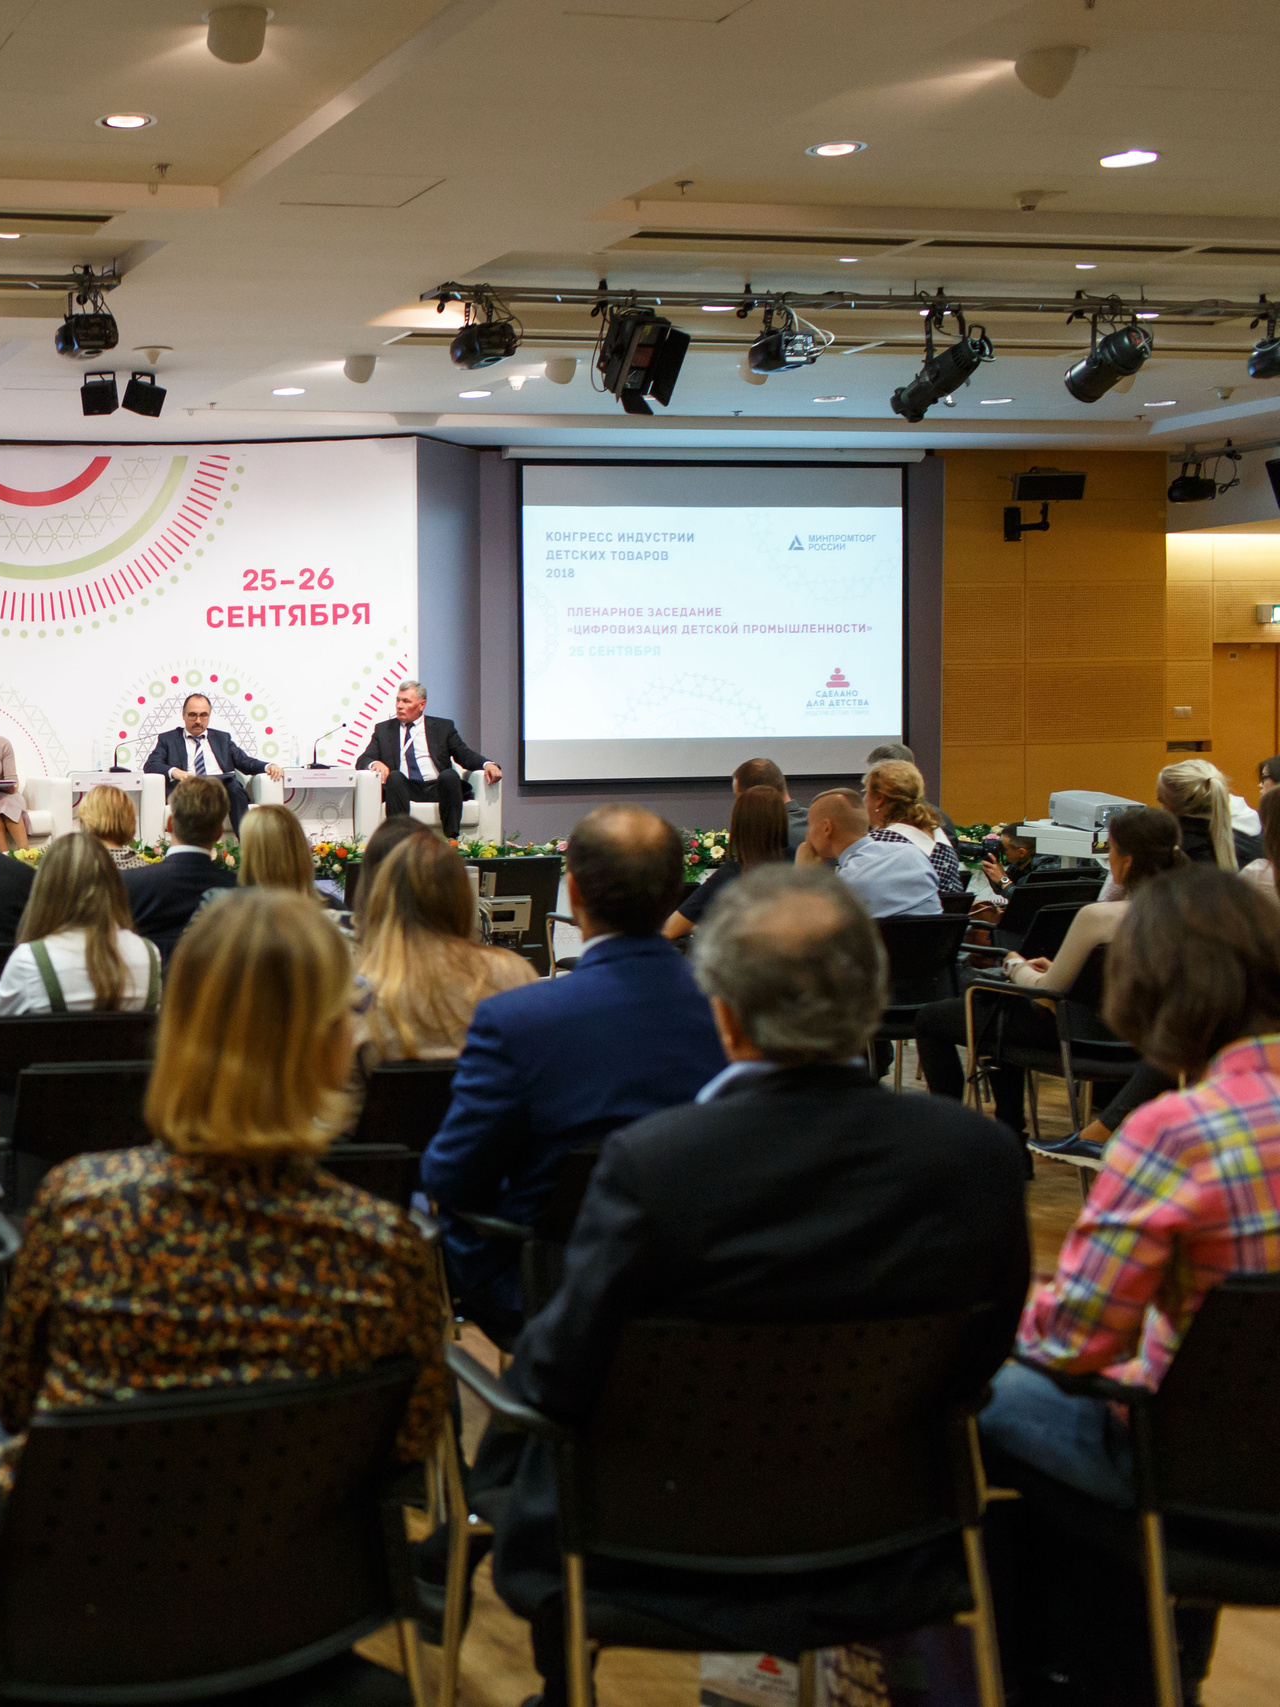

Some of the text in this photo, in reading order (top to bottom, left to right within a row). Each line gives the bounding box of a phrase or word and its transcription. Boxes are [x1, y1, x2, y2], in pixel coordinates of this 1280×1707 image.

[545, 531, 695, 544] КОНГРЕСС ИНДУСТРИИ
[808, 534, 877, 542] МИНПРОМТОРГ
[808, 543, 846, 551] РОССИИ
[545, 549, 669, 561] ДЕТСКИХ ТОВАРОВ
[545, 567, 575, 578] 2018
[206, 602, 370, 629] СЕНТЯБРЯ
[567, 606, 722, 618] ПЛЕНАРНОЕ ЗАСЕДАНИЕ
[681, 621, 740, 636] ДЕТСКОЙ
[568, 646, 662, 657] 25 СЕНТЯБРЯ
[815, 689, 859, 698] СДЕЛАНО
[806, 699, 869, 708] ДЛЯ ДЕТСТВА
